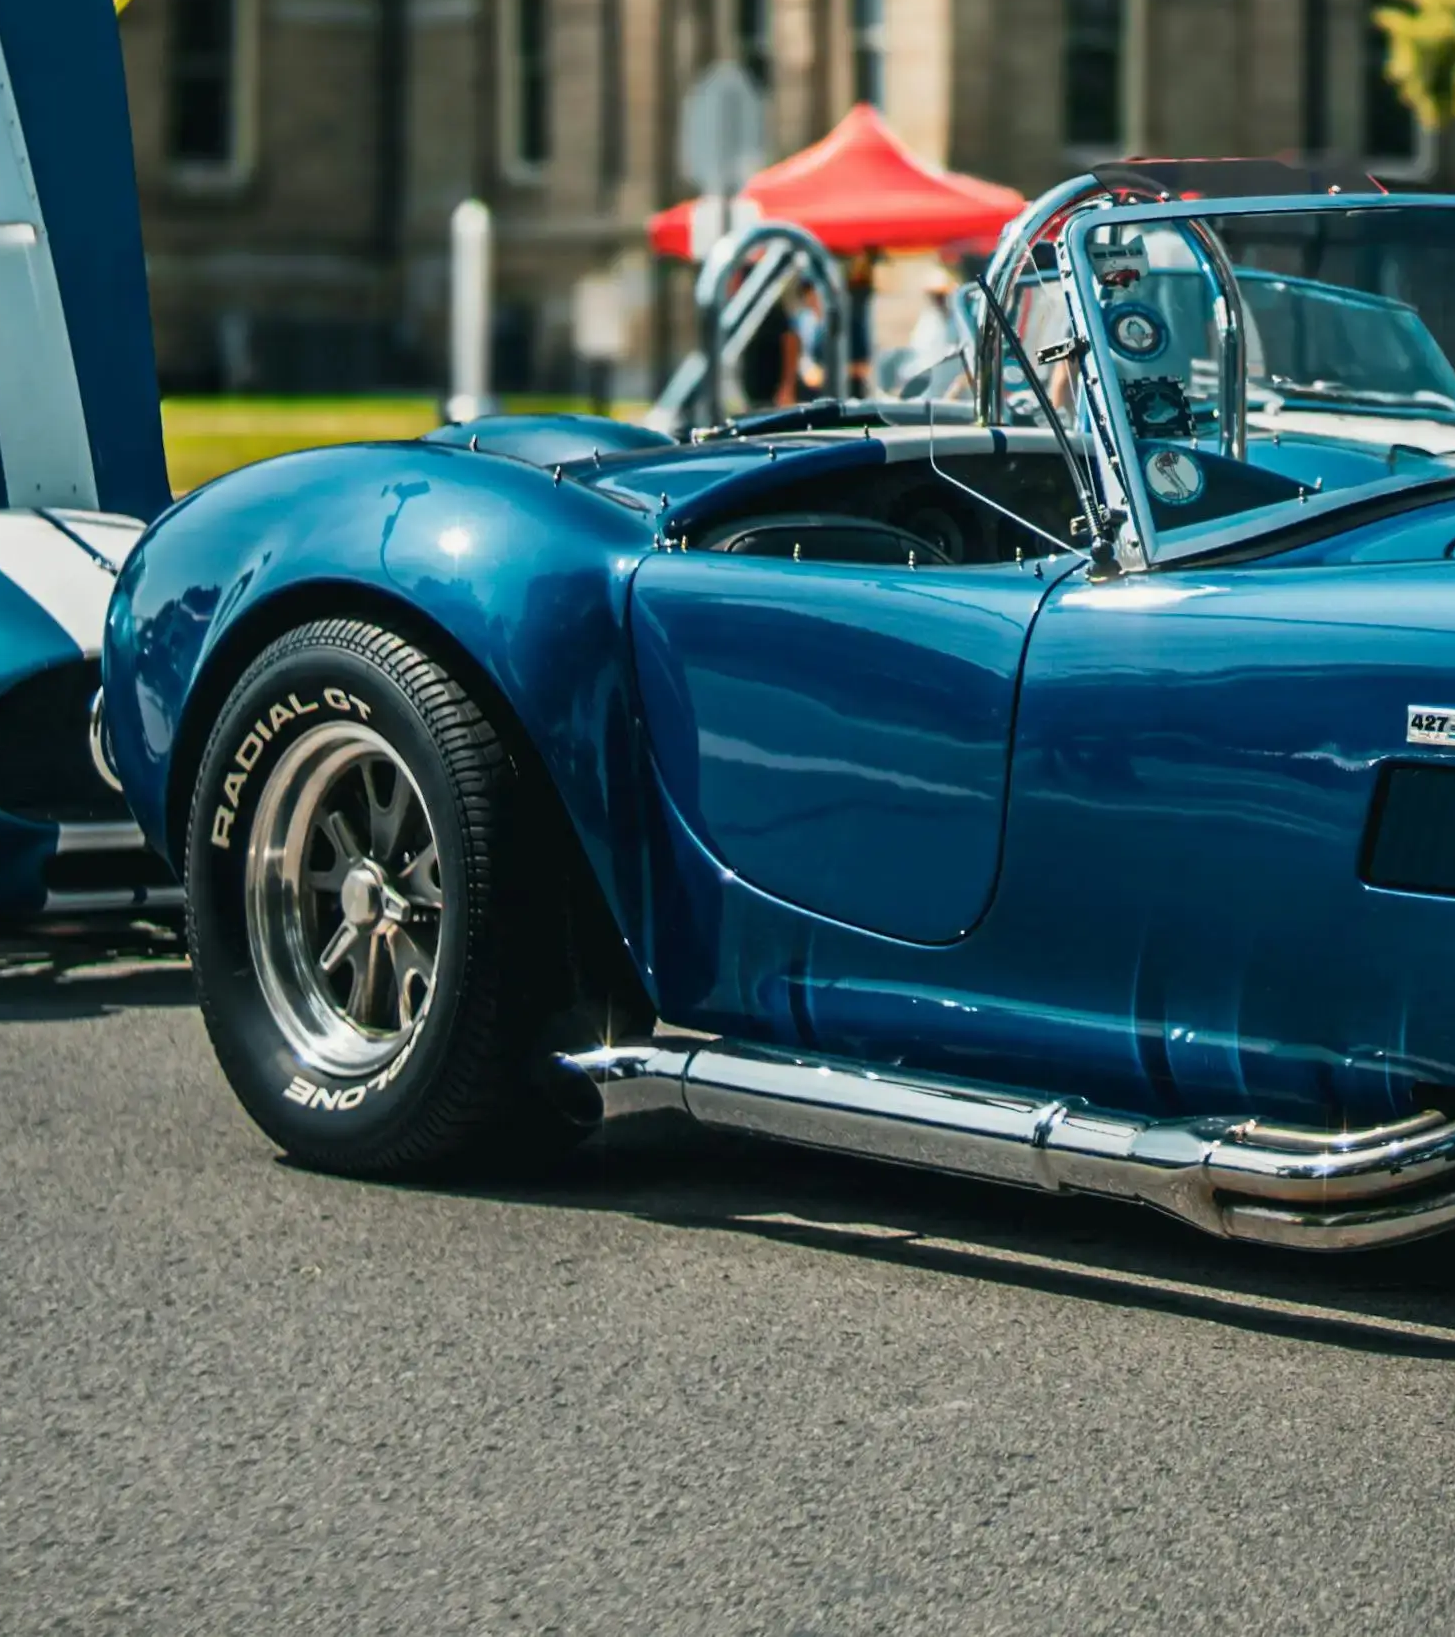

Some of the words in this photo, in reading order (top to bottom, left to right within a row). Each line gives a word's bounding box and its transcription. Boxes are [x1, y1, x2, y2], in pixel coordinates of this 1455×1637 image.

[211, 692, 319, 850] RADIAL
[323, 686, 372, 721] GT
[1411, 714, 1449, 733] 427
